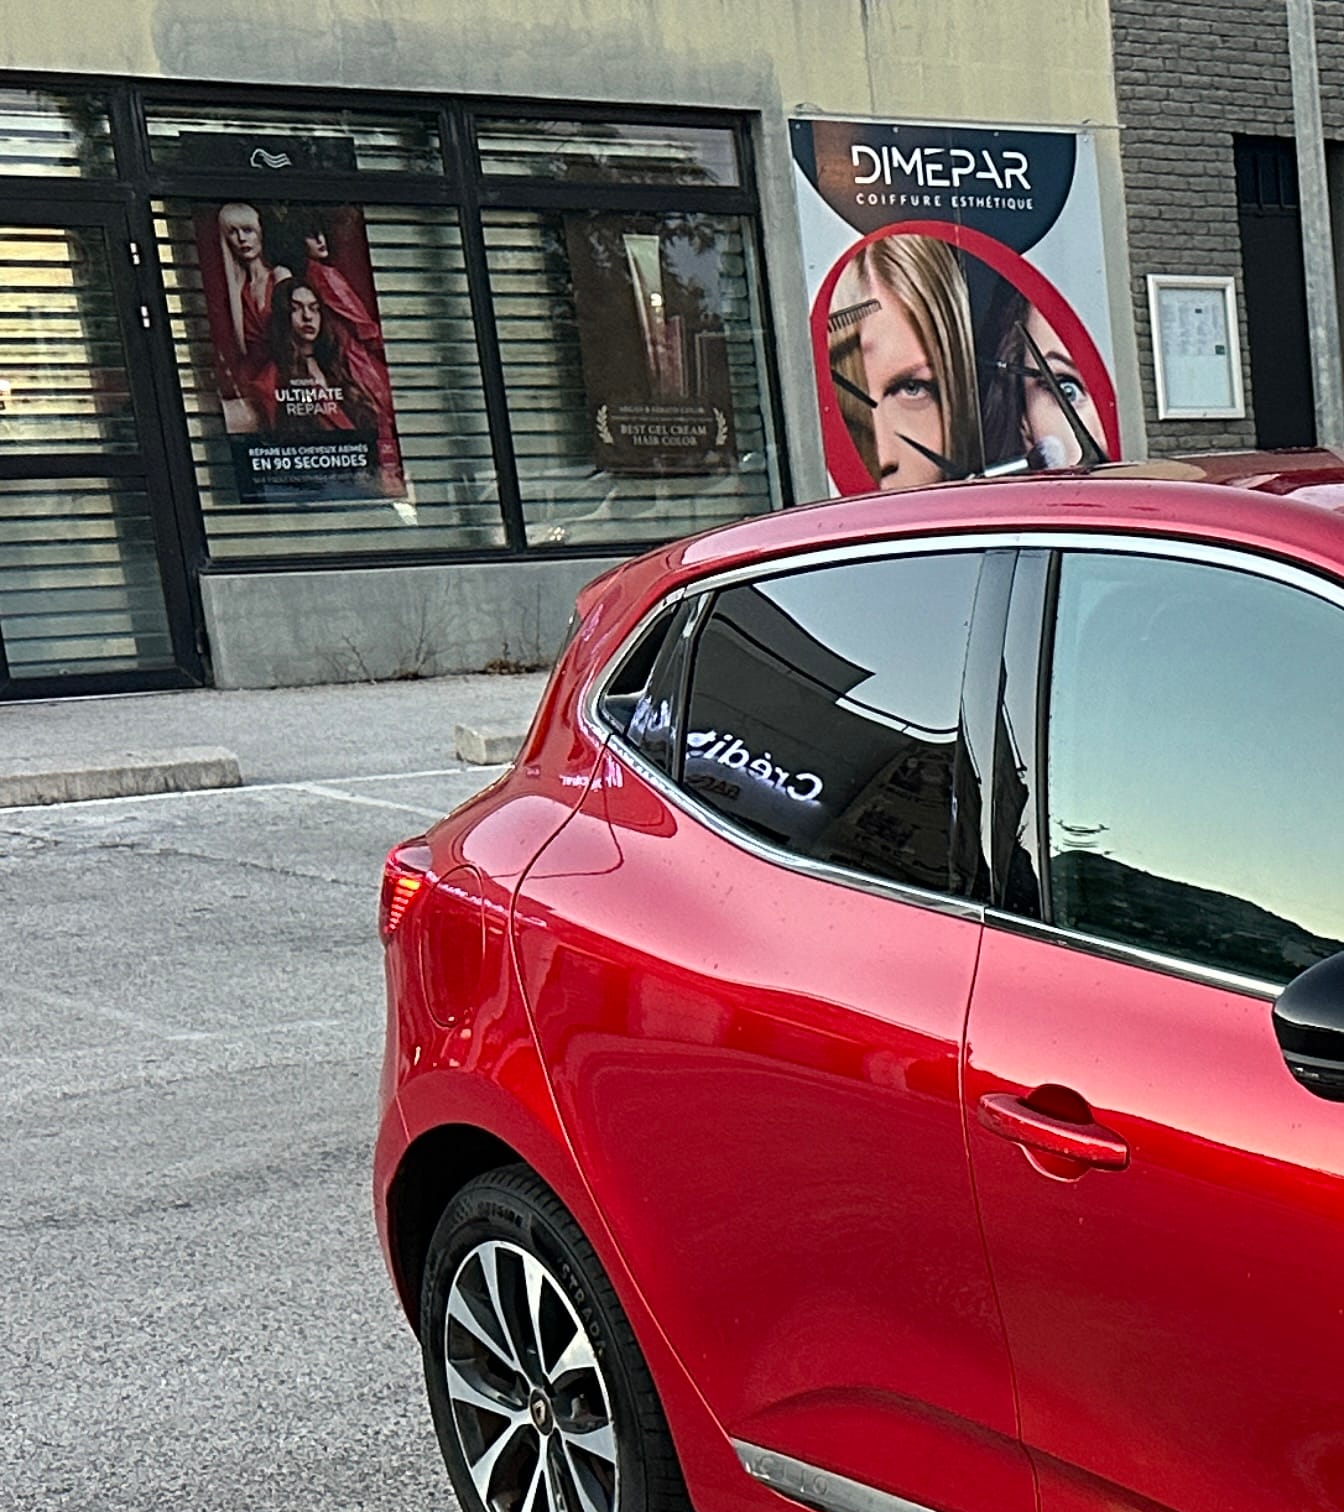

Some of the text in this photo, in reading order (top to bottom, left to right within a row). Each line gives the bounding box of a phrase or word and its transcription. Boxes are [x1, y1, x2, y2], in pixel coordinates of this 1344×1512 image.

[851, 145, 1031, 190] DIMEPAR
[855, 192, 1034, 210] COIFFURE ESTHÉTIQUE
[275, 387, 344, 402] ULTIMATE
[286, 402, 339, 416] REPAIR
[620, 424, 707, 436] BEST GEL CREAM
[633, 435, 698, 446] HAIR COLOR
[252, 454, 368, 470] EN 90 SECONDES
[759, 1454, 828, 1496] CLIO
